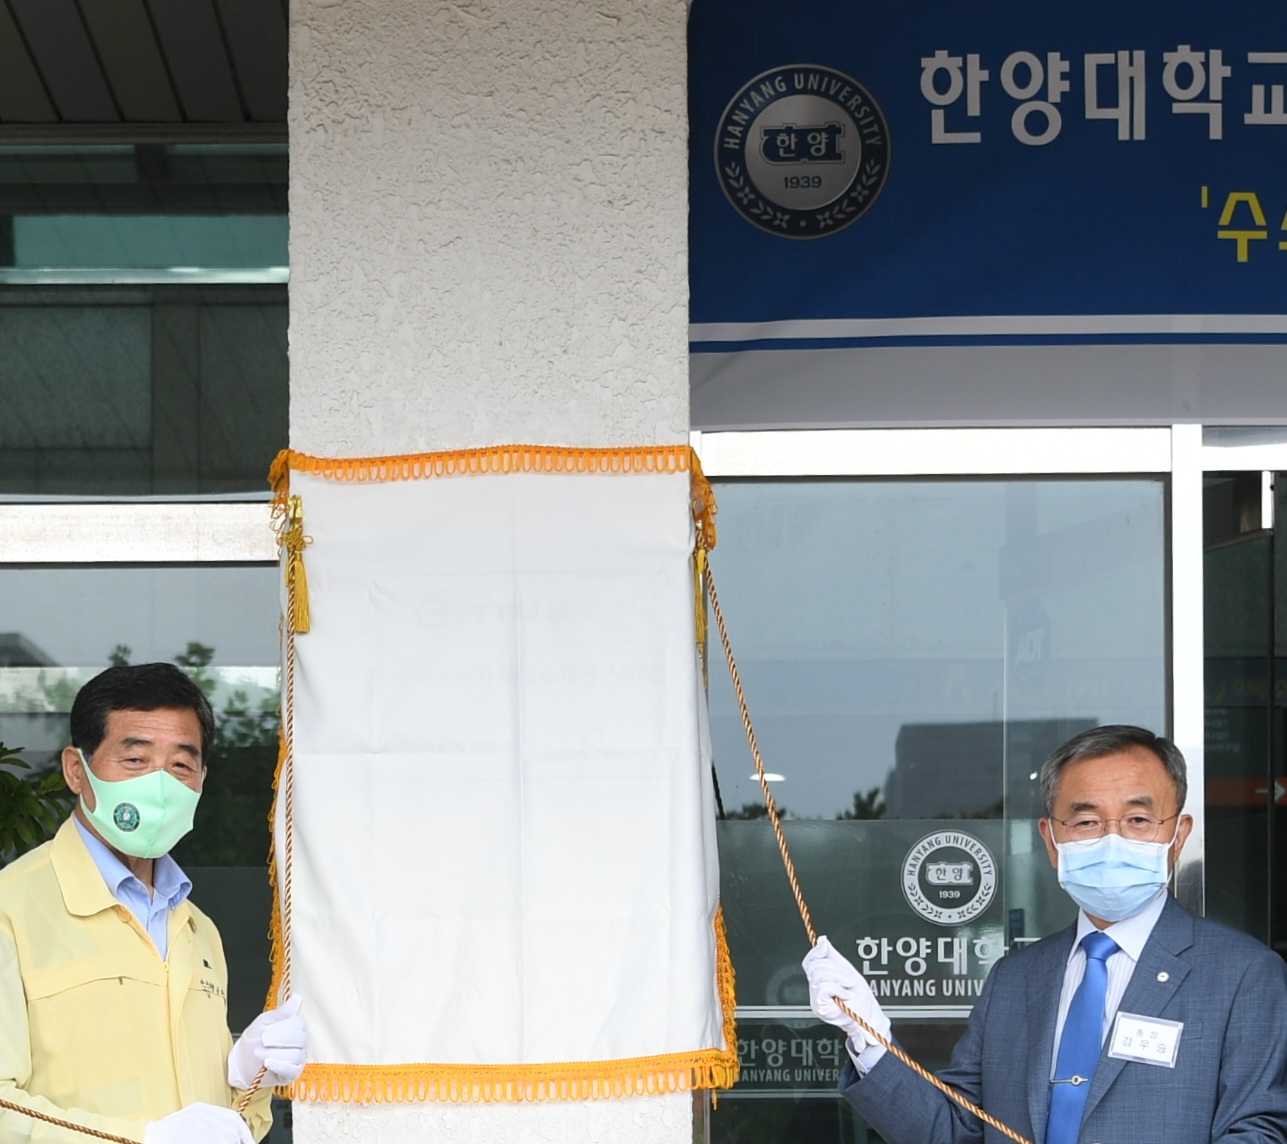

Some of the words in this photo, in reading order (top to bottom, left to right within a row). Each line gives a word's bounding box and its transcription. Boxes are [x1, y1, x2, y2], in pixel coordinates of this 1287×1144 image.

[724, 76, 787, 149] HANYANG
[794, 73, 881, 146] UNIVERSITY
[784, 176, 822, 189] 1939
[907, 836, 942, 876] HANYANG
[945, 835, 992, 876] UNIVERSITY
[939, 890, 960, 899] 1939
[856, 937, 1042, 977] 한양대학
